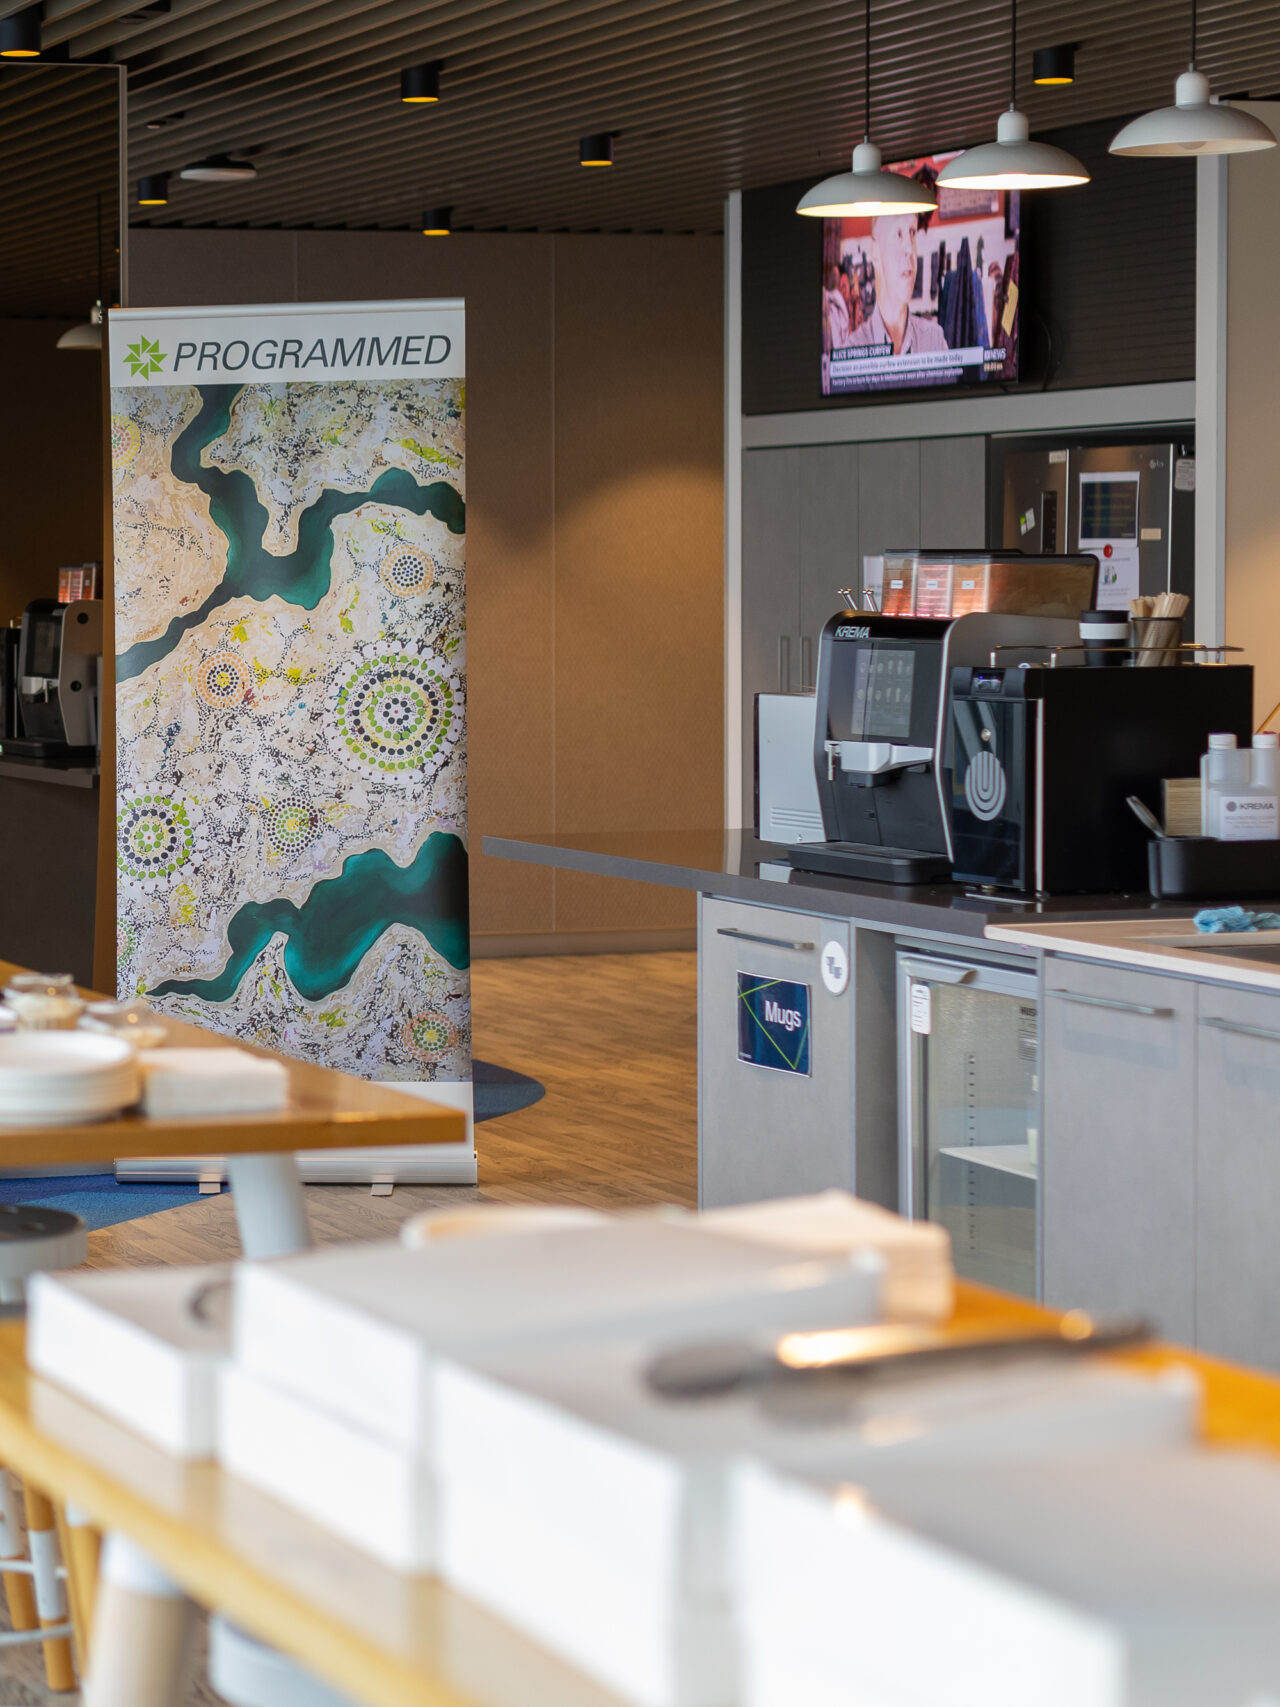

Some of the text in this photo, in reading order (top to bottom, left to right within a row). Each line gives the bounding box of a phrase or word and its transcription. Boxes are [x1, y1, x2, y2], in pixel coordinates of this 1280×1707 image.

[173, 334, 452, 372] PROGRAMMED
[834, 626, 871, 639] KREMA
[765, 1000, 802, 1031] Mugs
